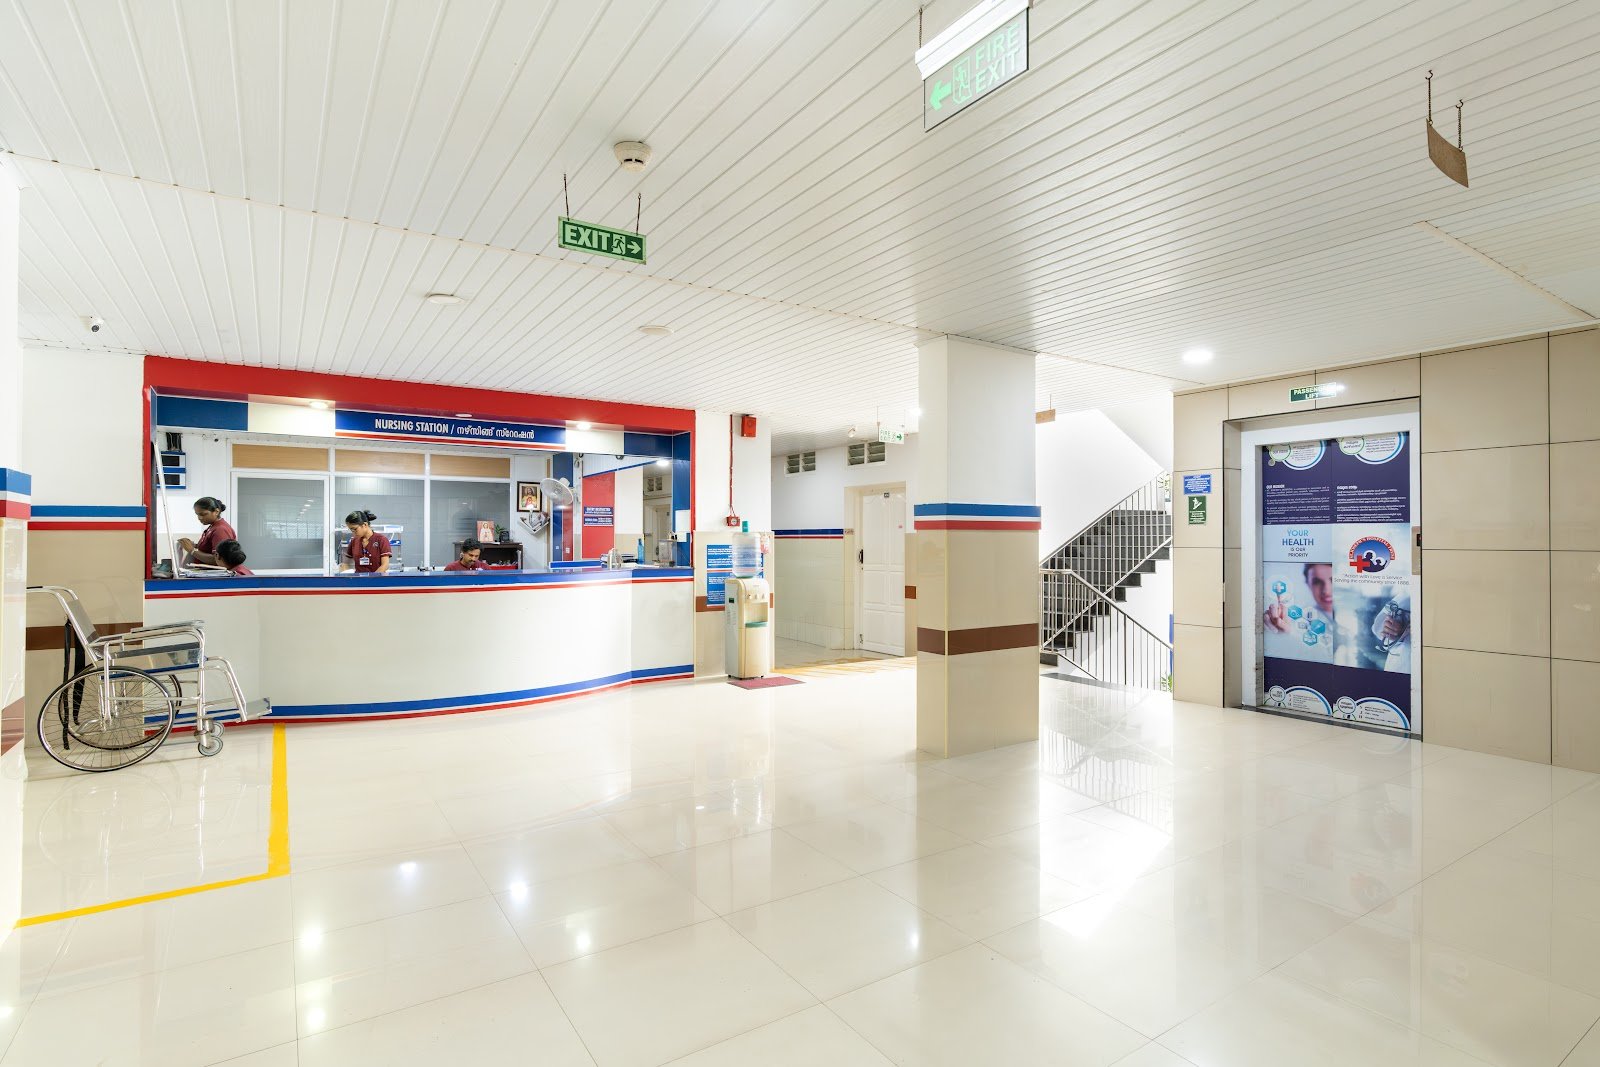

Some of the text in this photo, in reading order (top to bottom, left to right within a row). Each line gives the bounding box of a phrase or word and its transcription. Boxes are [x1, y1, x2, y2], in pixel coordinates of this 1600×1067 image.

[976, 23, 1019, 69] FIRE
[976, 47, 1019, 93] EXIT
[564, 223, 610, 251] EXIT
[375, 418, 414, 431] NURSING
[415, 421, 449, 434] STATION
[1282, 538, 1314, 546] HEALTH
[1287, 529, 1309, 537] YOUR
